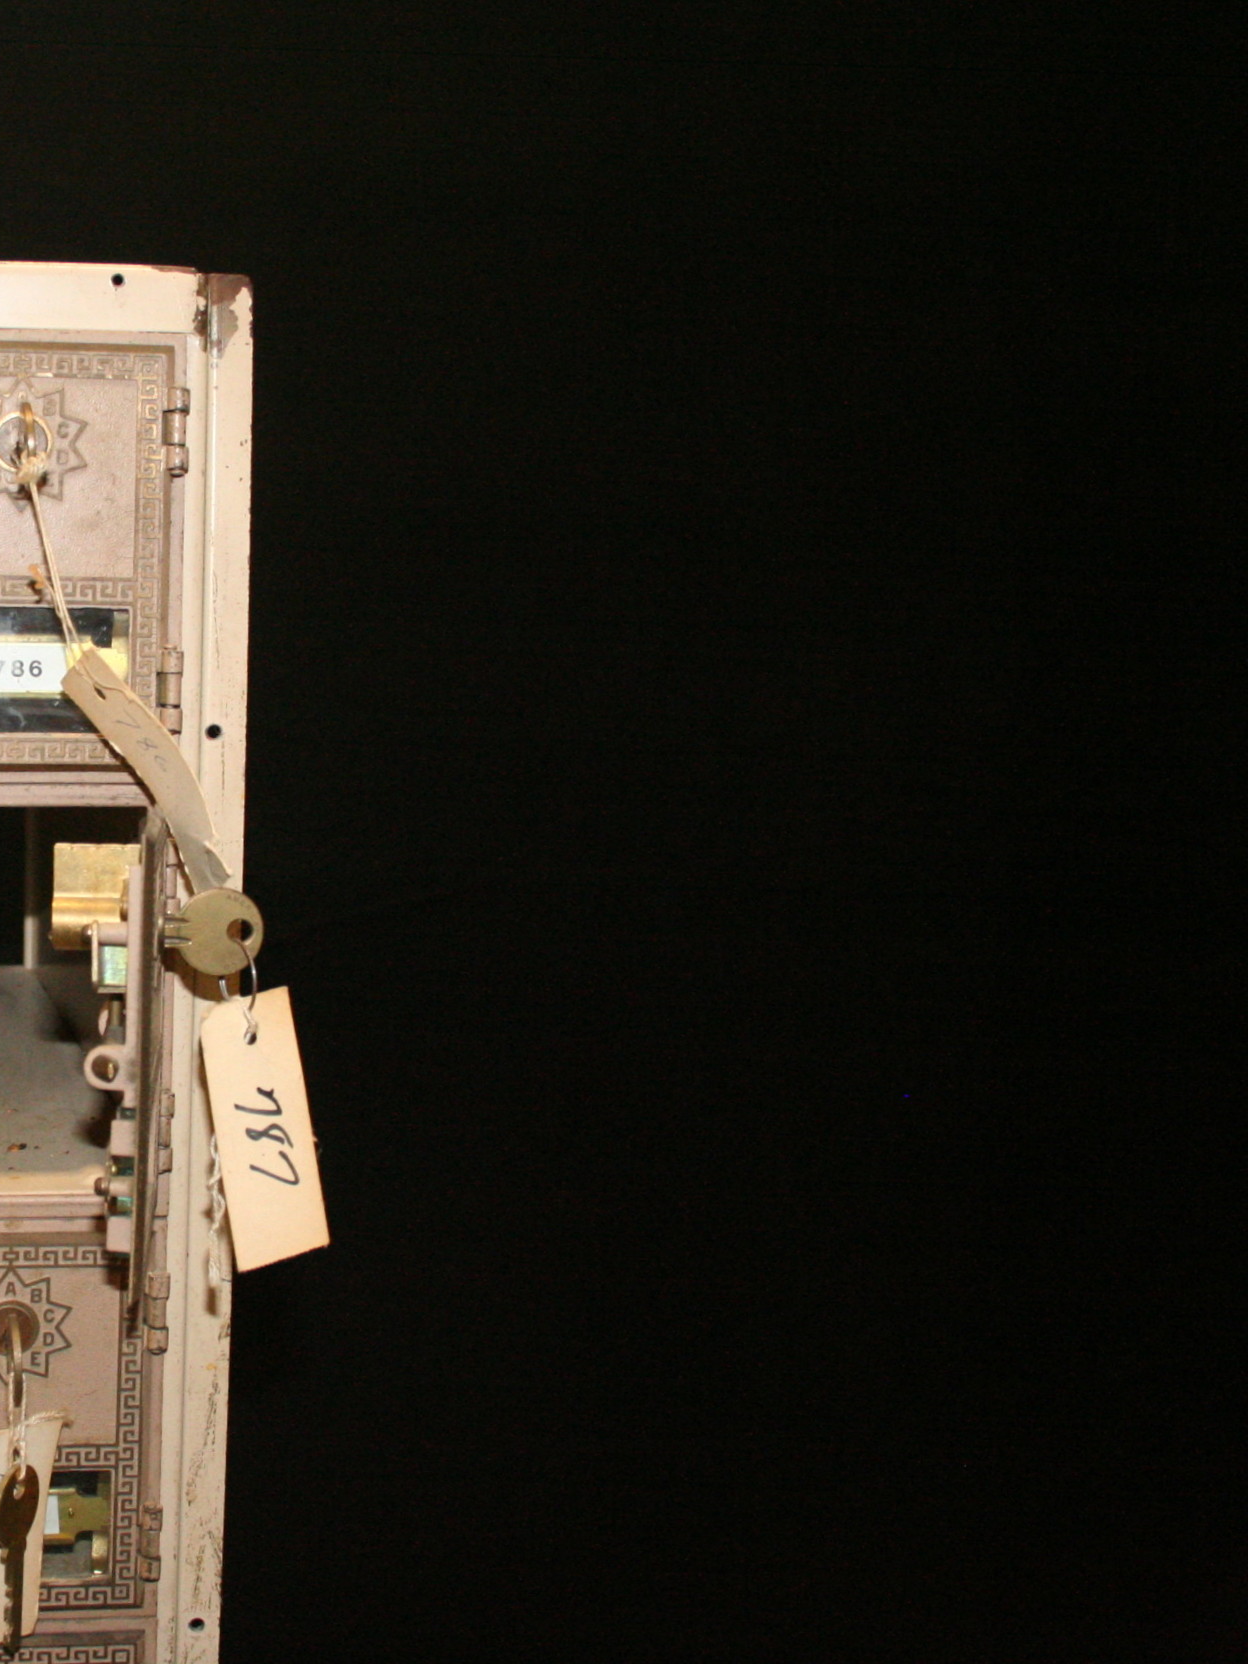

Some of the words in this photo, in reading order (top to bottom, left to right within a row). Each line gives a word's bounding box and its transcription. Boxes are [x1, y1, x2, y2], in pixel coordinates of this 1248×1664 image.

[5, 1282, 16, 1296] A
[31, 1288, 42, 1303] B
[43, 1309, 55, 1323] C
[43, 1332, 54, 1346] D
[31, 1352, 41, 1366] E
